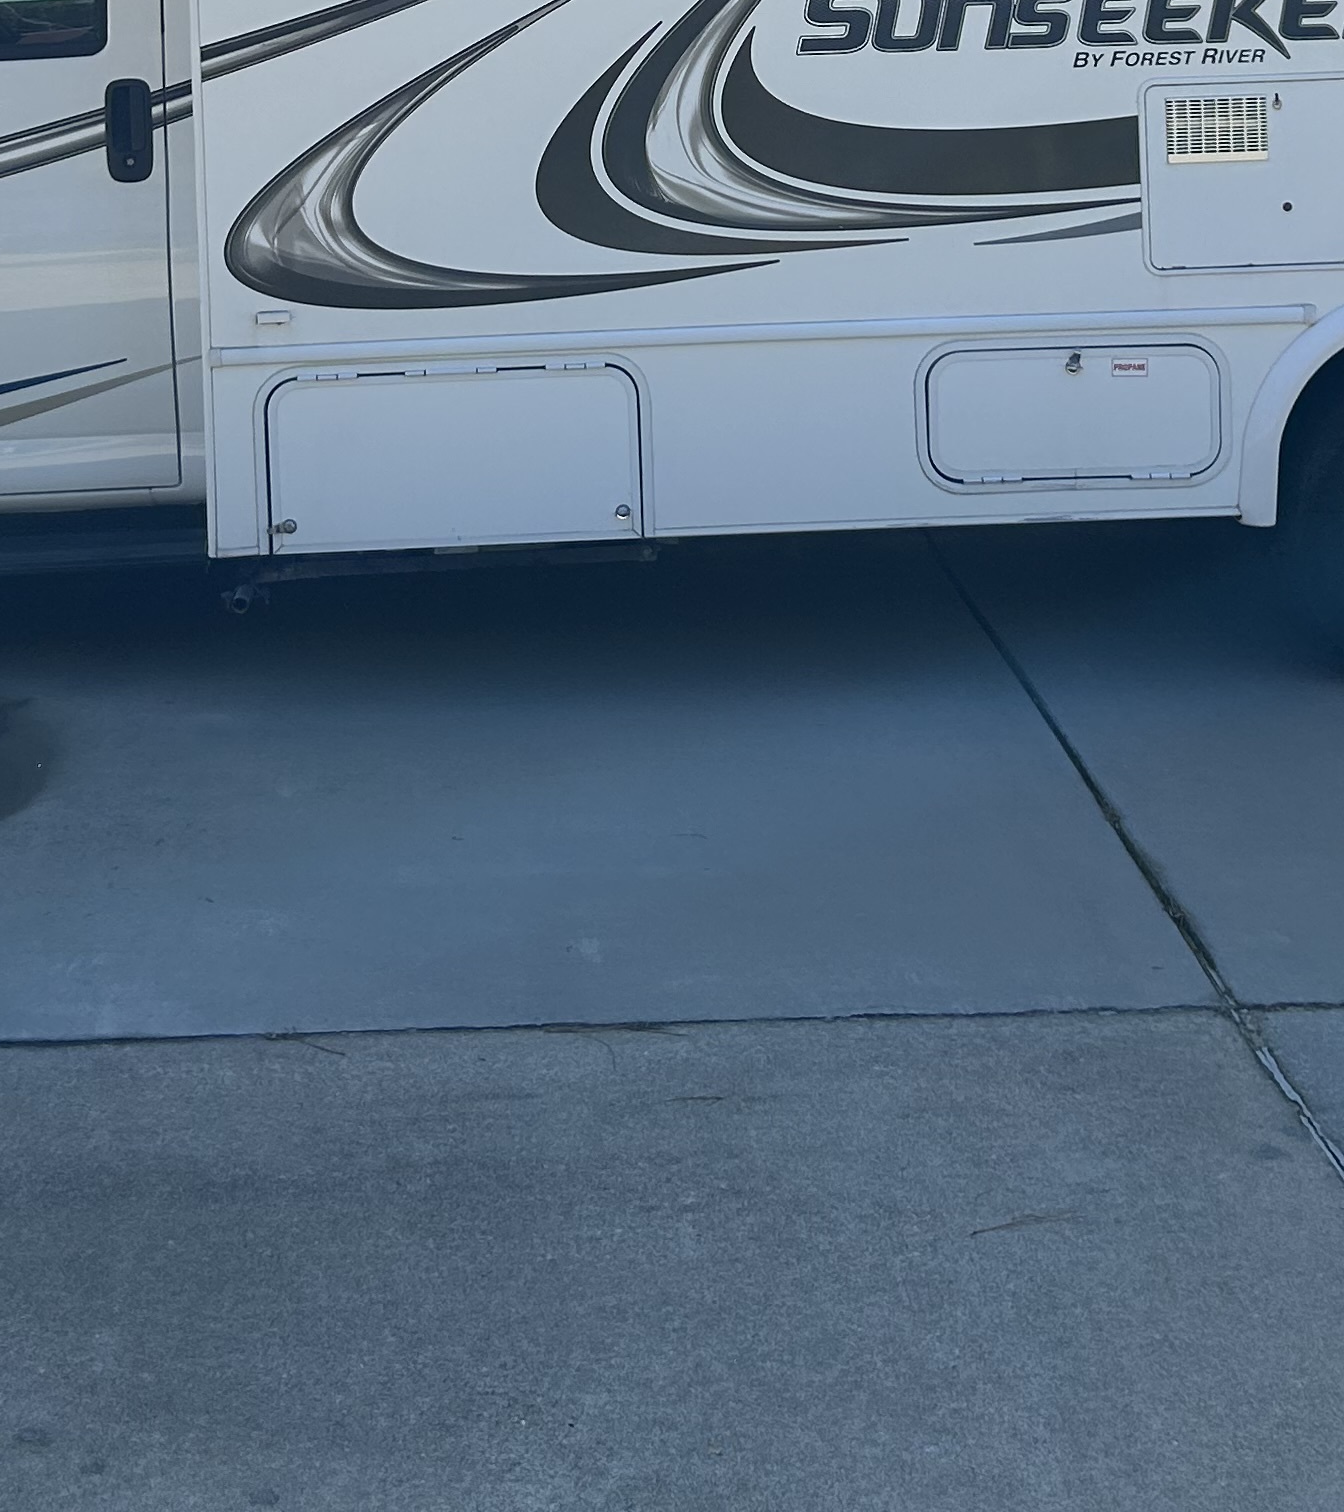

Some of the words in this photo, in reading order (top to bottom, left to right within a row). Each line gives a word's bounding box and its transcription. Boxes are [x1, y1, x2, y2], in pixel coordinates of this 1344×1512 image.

[1072, 51, 1105, 69] BY
[1109, 49, 1197, 68] FOREST
[1201, 47, 1267, 65] RIVER
